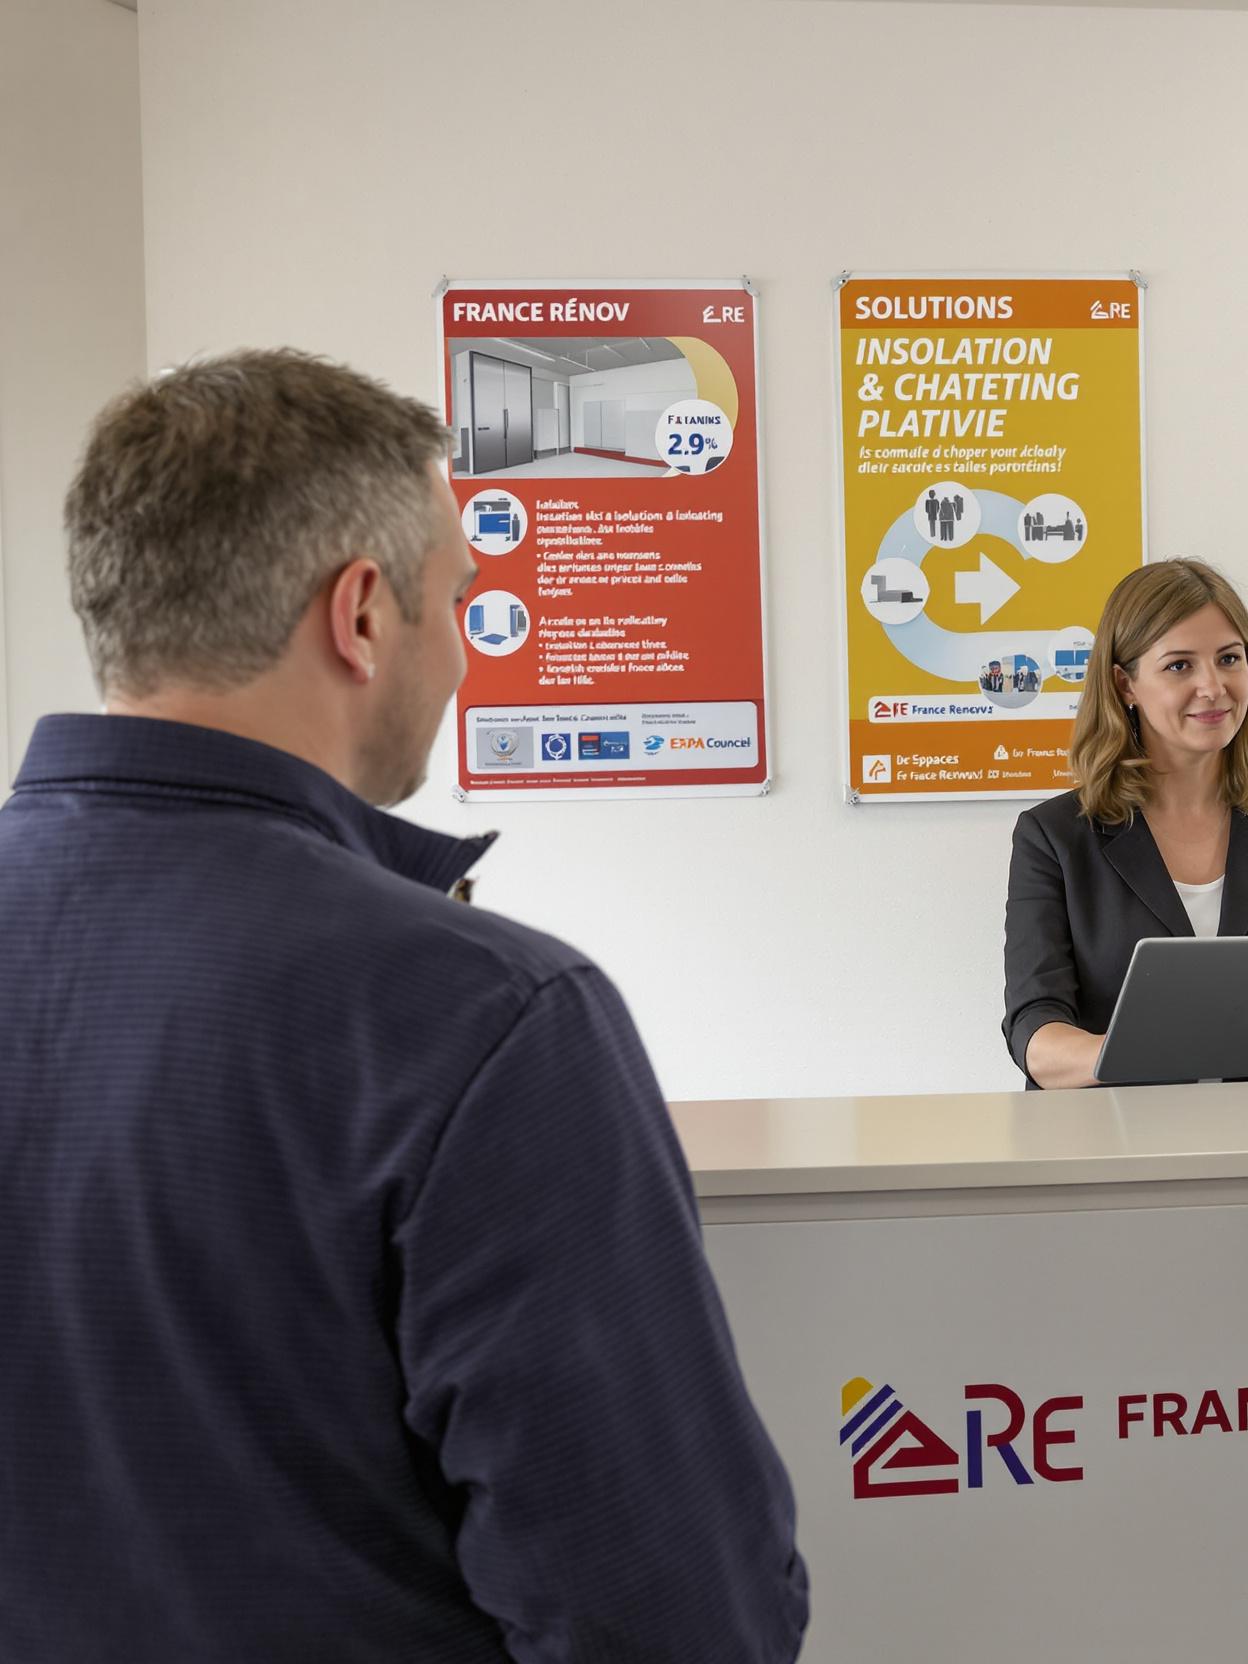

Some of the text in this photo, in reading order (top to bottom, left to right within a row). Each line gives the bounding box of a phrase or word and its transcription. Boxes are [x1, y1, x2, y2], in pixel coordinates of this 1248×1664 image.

[453, 298, 630, 322] FRANCE RÉNOV
[855, 295, 1013, 320] SOLUTIONS
[855, 337, 1053, 365] INSOLATION
[857, 372, 1080, 401] & CHATETING
[857, 409, 1007, 437] PLATIVIE
[912, 705, 946, 715] France
